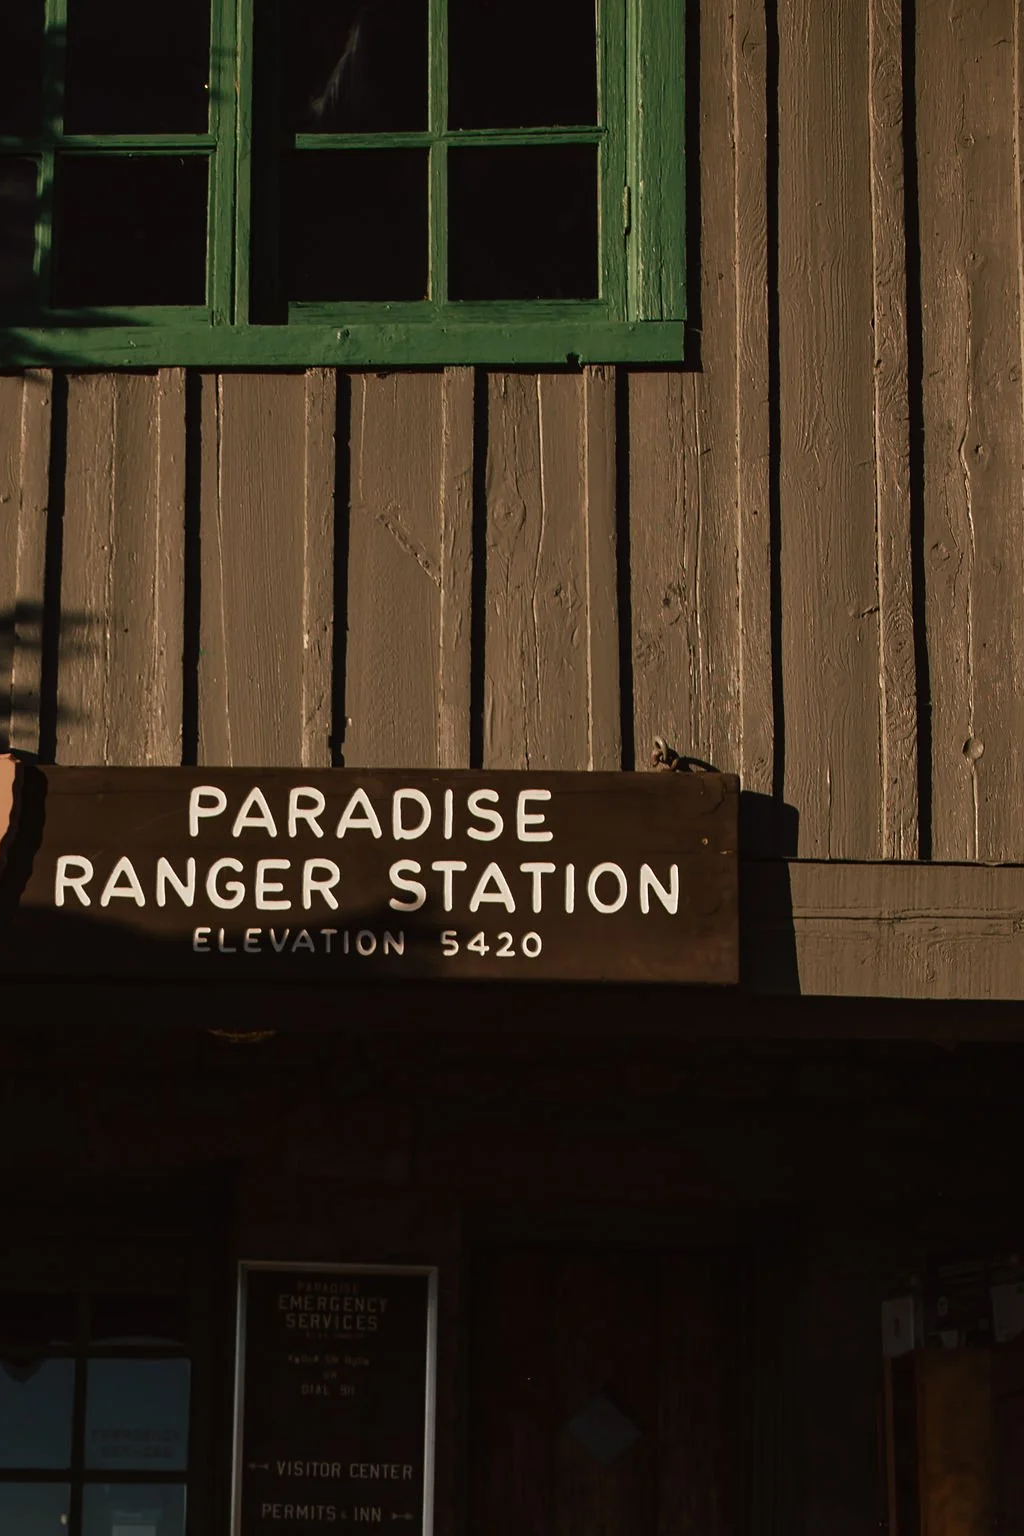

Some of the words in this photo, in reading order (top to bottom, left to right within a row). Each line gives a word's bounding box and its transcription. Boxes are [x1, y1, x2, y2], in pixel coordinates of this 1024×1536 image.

[188, 785, 555, 842] PARADISE
[54, 855, 342, 911] RANGER
[388, 859, 681, 915] STATION
[192, 926, 406, 957] ELEVATION
[440, 929, 543, 958] 5420
[278, 1293, 388, 1313] EMERGENCY
[285, 1312, 378, 1331] SERVICES
[301, 1383, 330, 1397] DIAL
[277, 1459, 342, 1478] VISITOR
[350, 1462, 413, 1481] CENTER
[262, 1503, 336, 1522] PERMITS
[354, 1506, 382, 1523] INN
